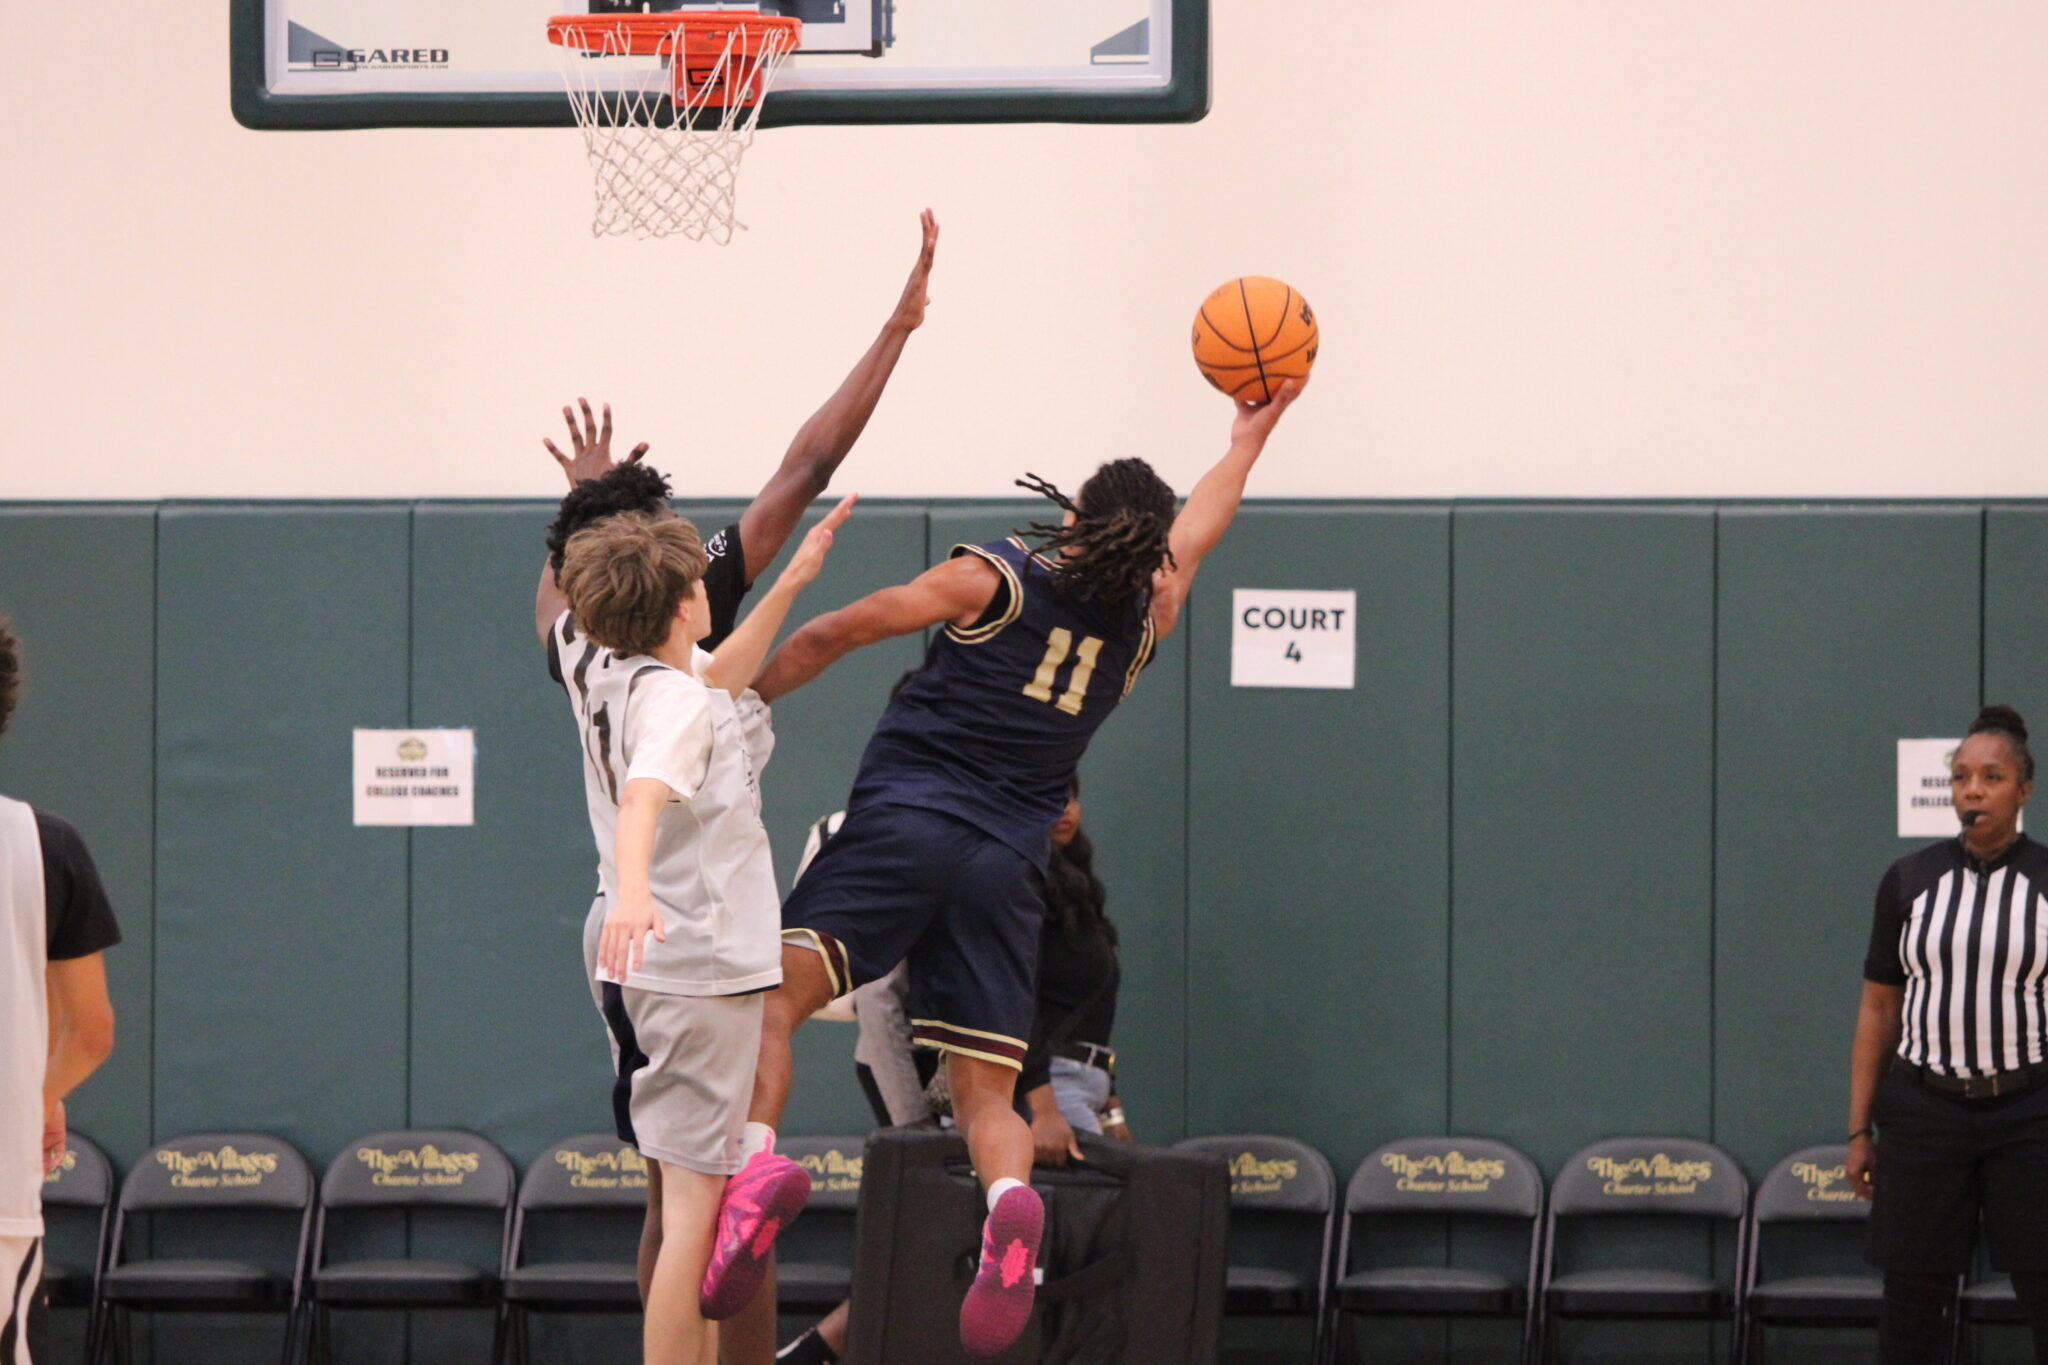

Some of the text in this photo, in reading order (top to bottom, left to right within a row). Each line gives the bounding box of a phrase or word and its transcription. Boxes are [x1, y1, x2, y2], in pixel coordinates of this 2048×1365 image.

[347, 49, 449, 63] GARED
[1243, 607, 1345, 630] COURT
[1284, 641, 1302, 663] 4
[1022, 626, 1104, 716] 11
[157, 1146, 278, 1174] The Villages
[357, 1144, 479, 1175] The Villages
[555, 1150, 597, 1175] The
[1381, 1151, 1505, 1181] The Villages
[1587, 1153, 1712, 1183] The Villages
[171, 1172, 263, 1188] Charter School
[372, 1171, 464, 1187] Charter School
[1396, 1177, 1490, 1192] Charter School
[1791, 1162, 1834, 1189] The
[1603, 1181, 1697, 1195] Charter School
